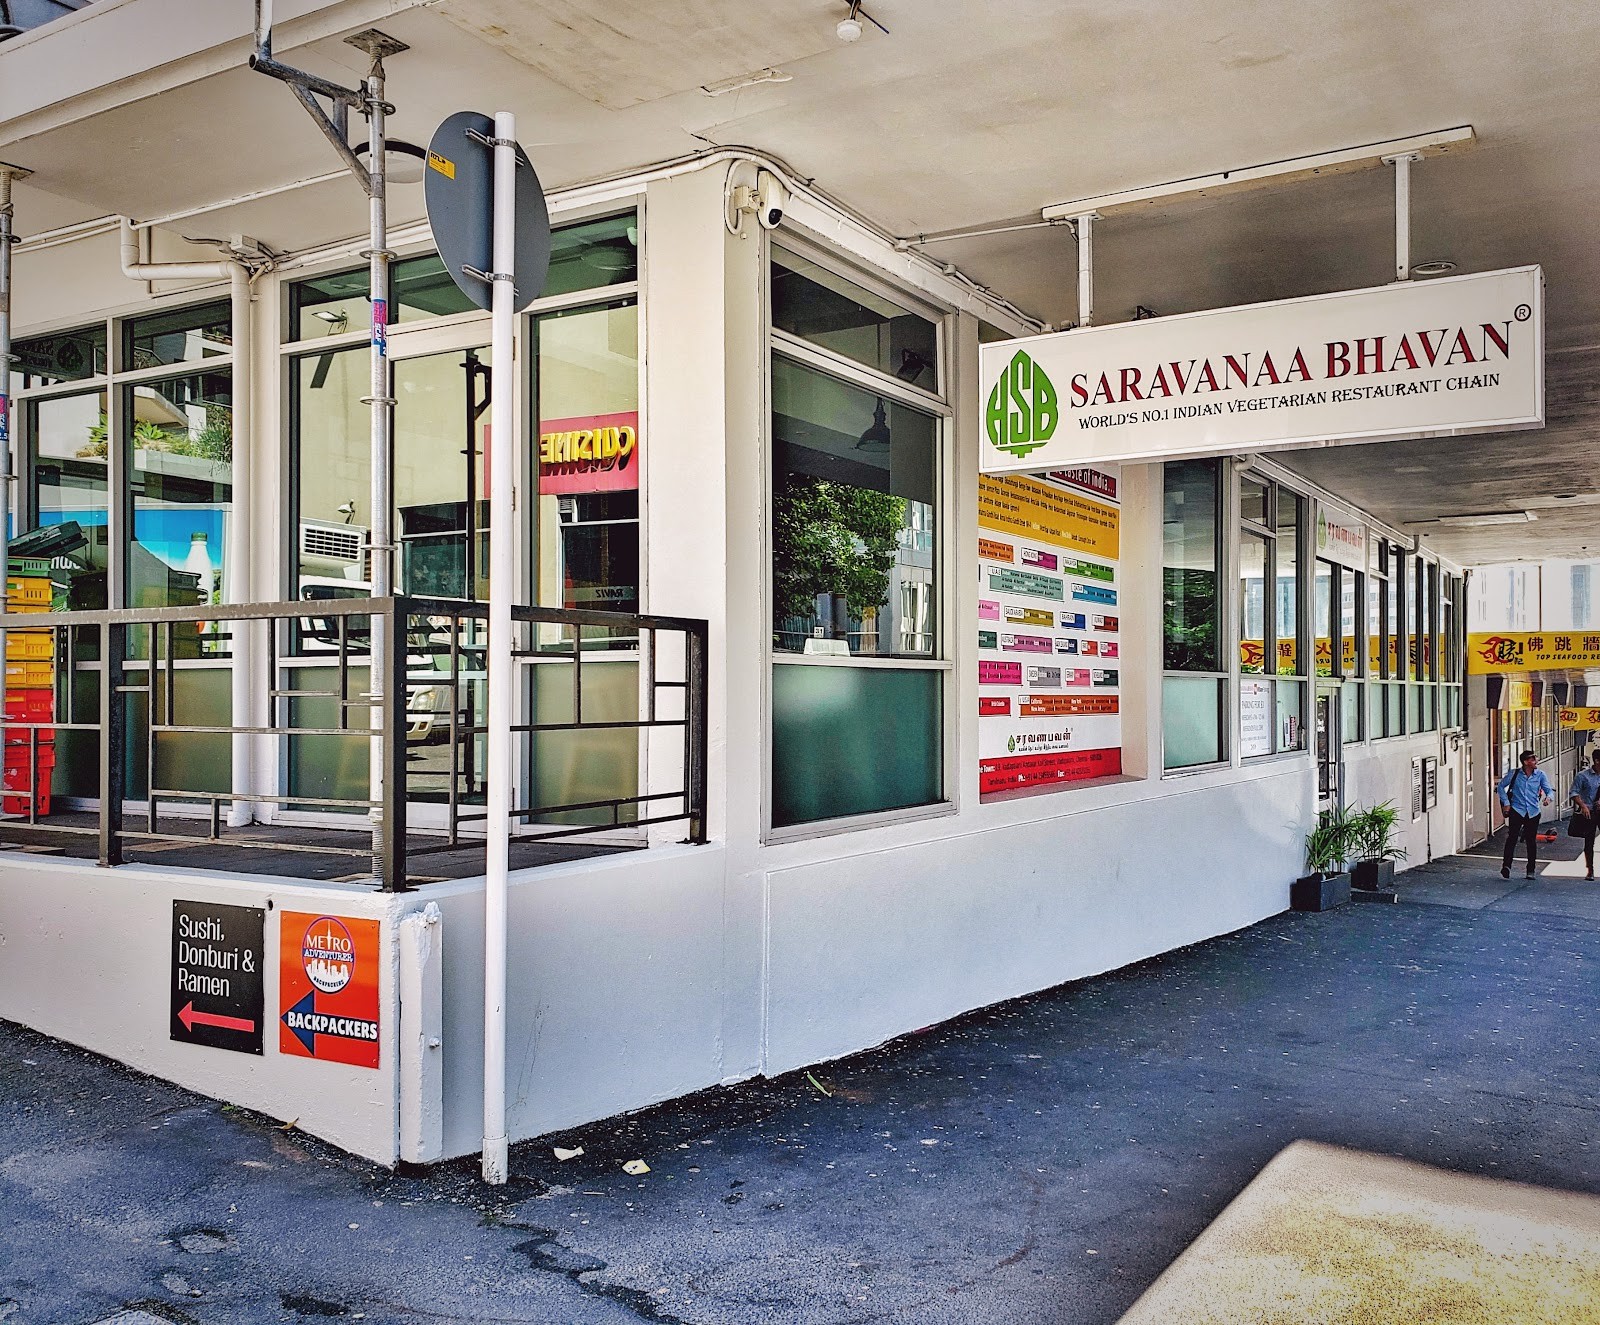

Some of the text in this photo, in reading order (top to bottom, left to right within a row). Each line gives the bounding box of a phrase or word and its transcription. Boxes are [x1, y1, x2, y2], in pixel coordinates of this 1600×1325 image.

[1070, 346, 1314, 408] SARAVANAA
[1323, 320, 1513, 379] BHAVAN
[986, 349, 1058, 445] HSB
[1078, 373, 1500, 430] WORLD'S NO.1 INDIAN VEGETARIAN RESTAURANT CHAIN
[179, 913, 225, 941] Sushi,
[178, 940, 255, 973] Donburi &
[306, 934, 351, 952] METRO
[178, 967, 230, 997] Ramen
[287, 1011, 378, 1040] BACKPACKERS
